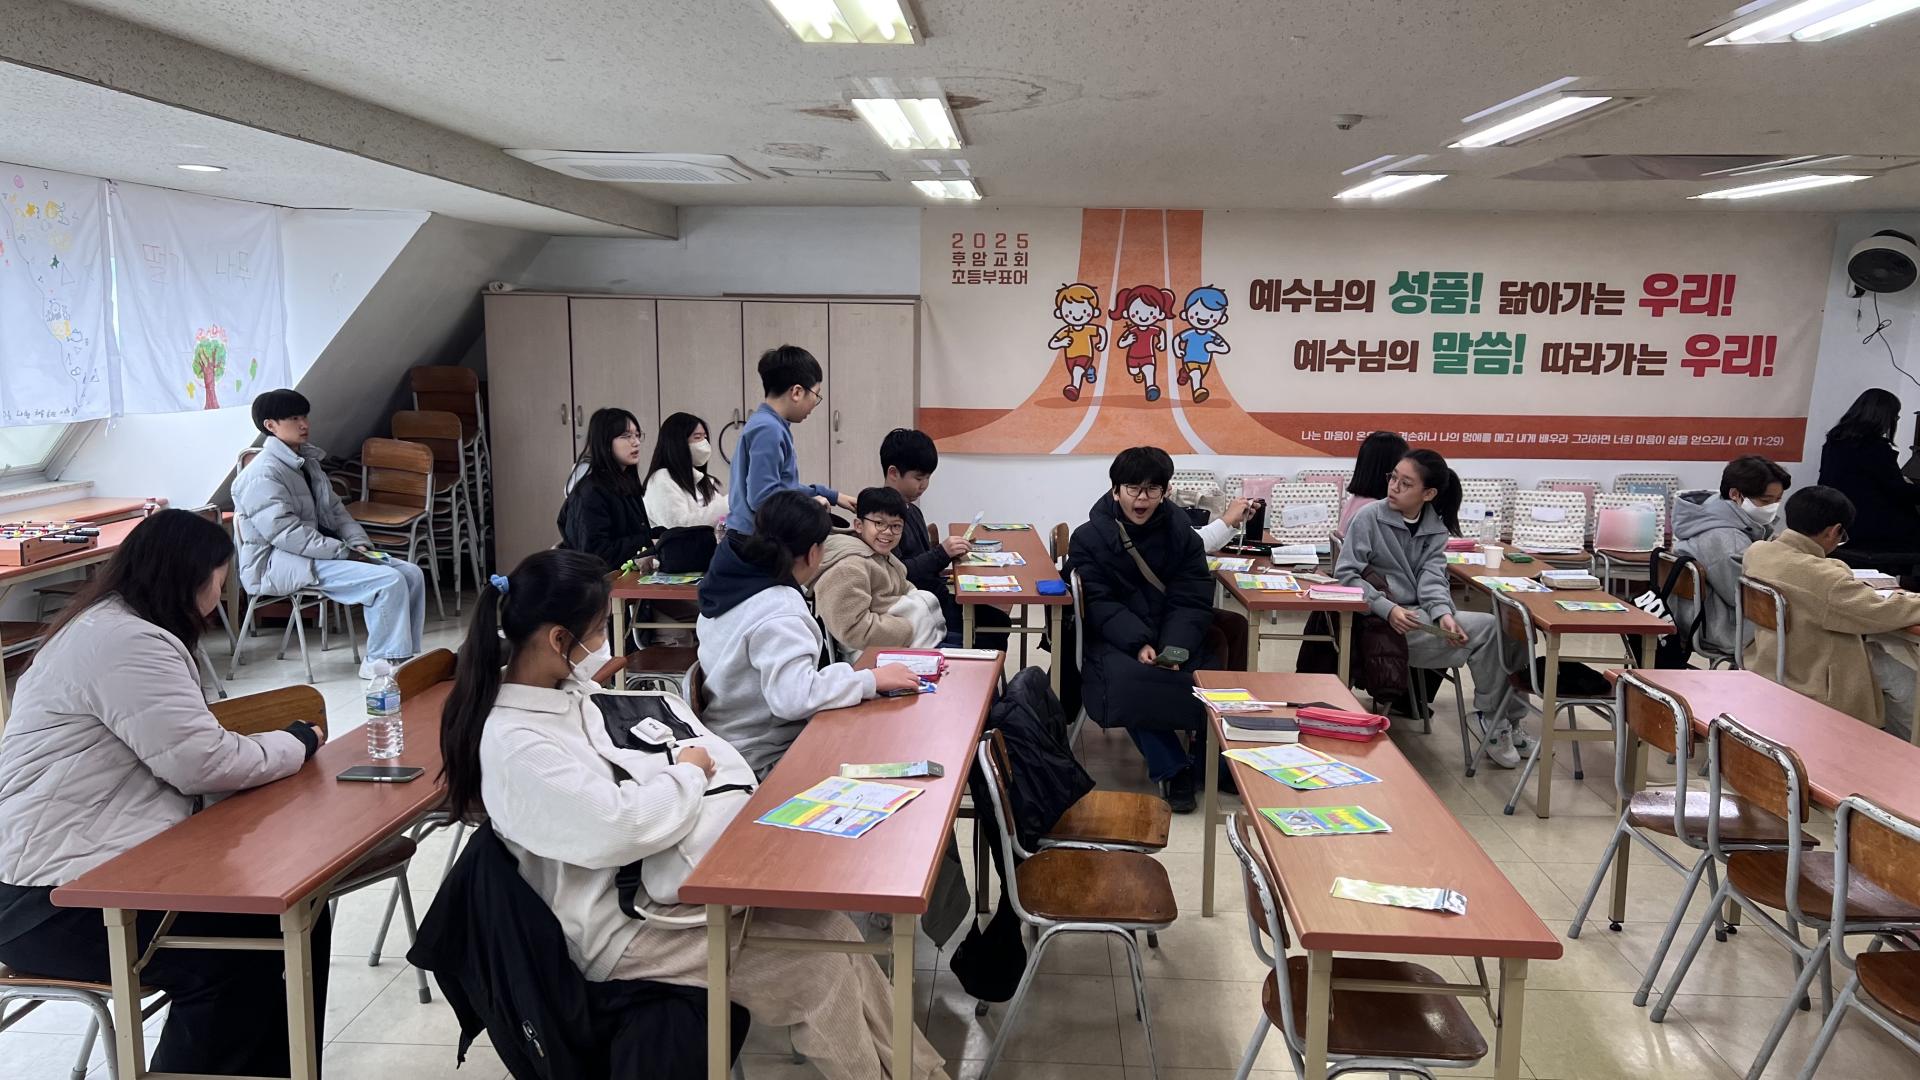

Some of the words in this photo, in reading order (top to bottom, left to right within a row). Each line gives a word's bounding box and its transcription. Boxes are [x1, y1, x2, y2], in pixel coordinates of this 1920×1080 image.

[952, 232, 1029, 249] 2025
[951, 269, 1028, 285] 초등부표어
[1249, 278, 1376, 313] 예수님의
[1388, 270, 1484, 315] 성품!
[1499, 281, 1626, 316] 닮아가는
[1638, 272, 1737, 318] 우리!
[1293, 339, 1420, 373] 예수님의
[1432, 331, 1527, 375] 말씀!
[1540, 342, 1668, 376] 따라가는
[1680, 334, 1778, 378] 우리!
[1301, 430, 1321, 441] 나는
[1324, 430, 1353, 441] 마음이
[1439, 432, 1460, 442] 나의
[1462, 432, 1491, 443] 멍에를
[1494, 433, 1514, 443] 메고
[1516, 433, 1536, 443] 내게
[1539, 433, 1568, 444] 배우라
[1571, 433, 1611, 445] 그리하면
[1613, 434, 1633, 445] 너희
[1636, 434, 1665, 445] 마음이
[1668, 435, 1688, 446] 쉼을
[1690, 435, 1731, 446] 얻으리니
[1735, 435, 1749, 446] (마
[1752, 436, 1784, 447] 11:29)
